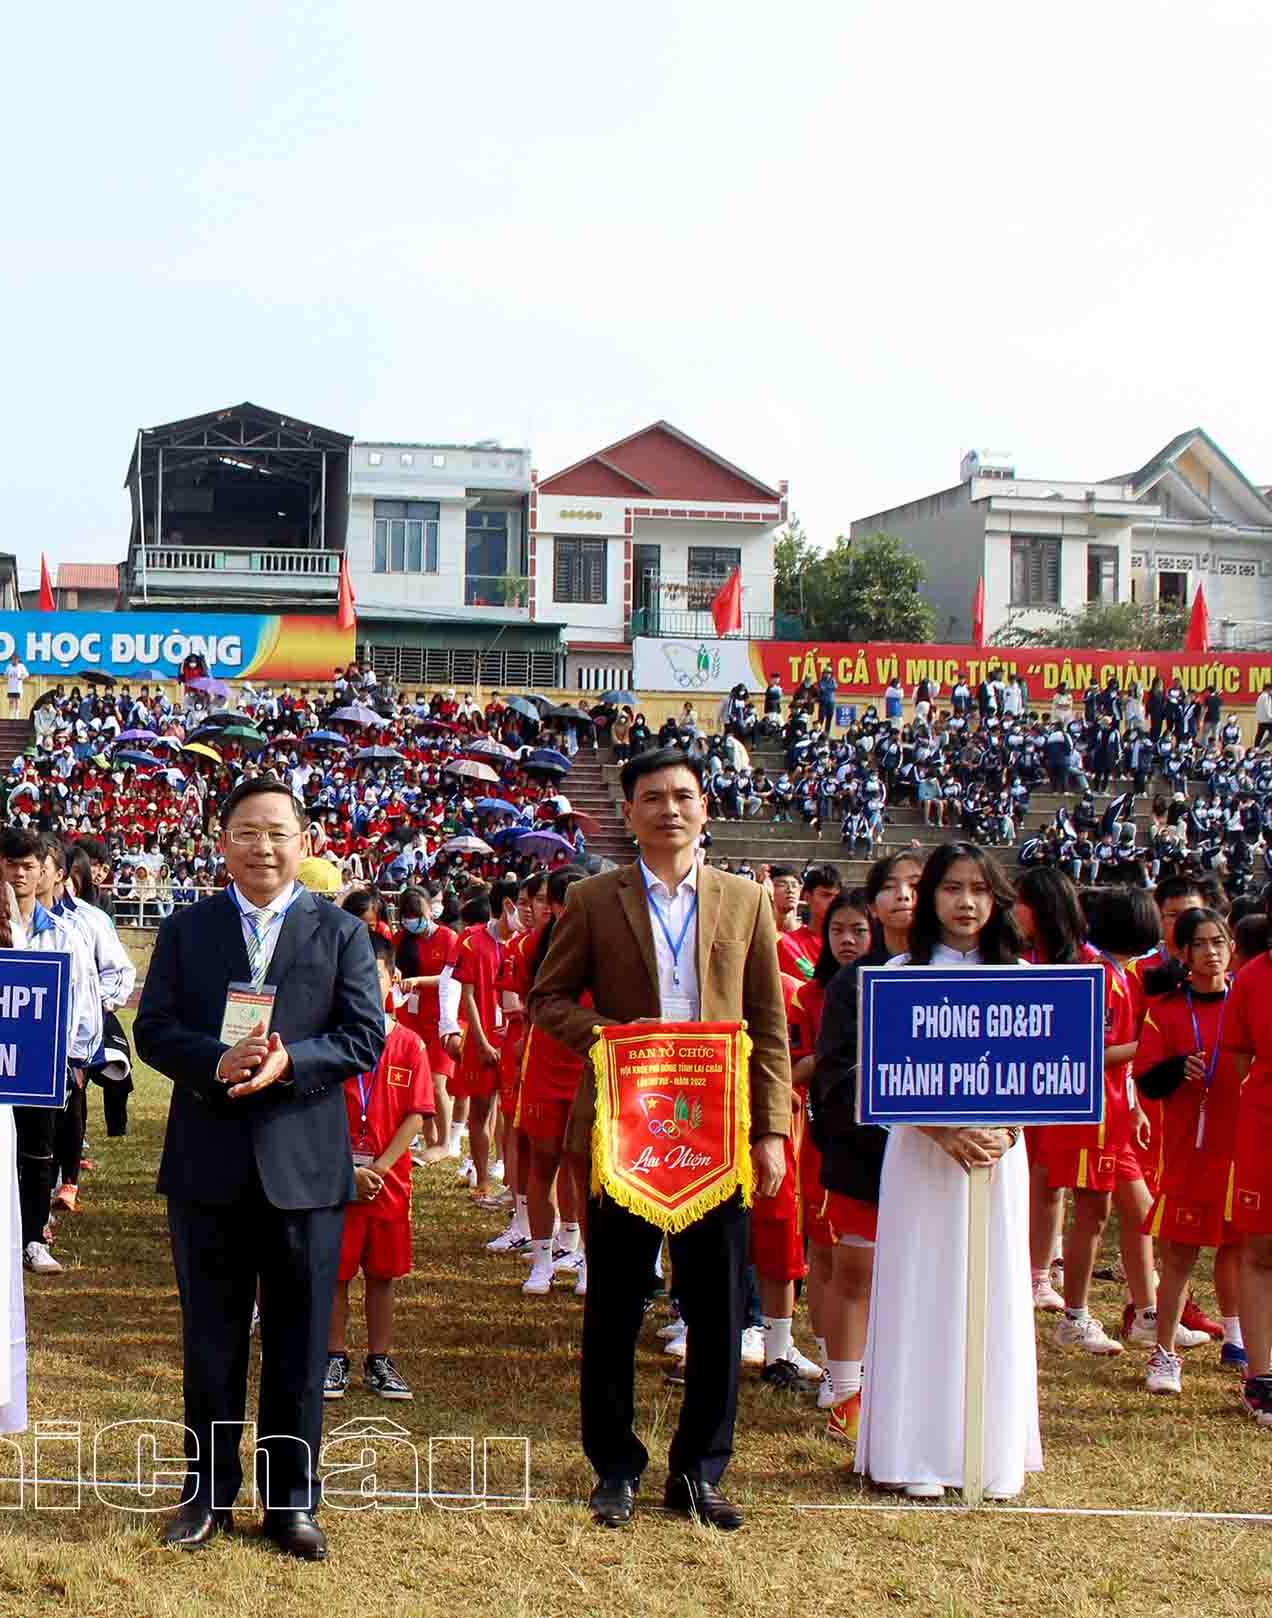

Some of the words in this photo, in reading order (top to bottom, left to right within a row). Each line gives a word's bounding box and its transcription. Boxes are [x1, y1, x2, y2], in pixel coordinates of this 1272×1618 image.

[26, 632, 102, 668] HỌC
[111, 628, 241, 666] ĐƯỜNG
[838, 649, 870, 684] CẢ
[877, 653, 898, 685] VÌ
[911, 996, 980, 1039] PHÒNG
[986, 1004, 1055, 1038] GD&ĐT
[628, 1047, 657, 1060] BAN
[877, 1056, 944, 1097] THÀNH
[949, 1050, 991, 1096] PHỐ
[995, 1062, 1026, 1096] LAI
[1032, 1055, 1087, 1096] CHÂU
